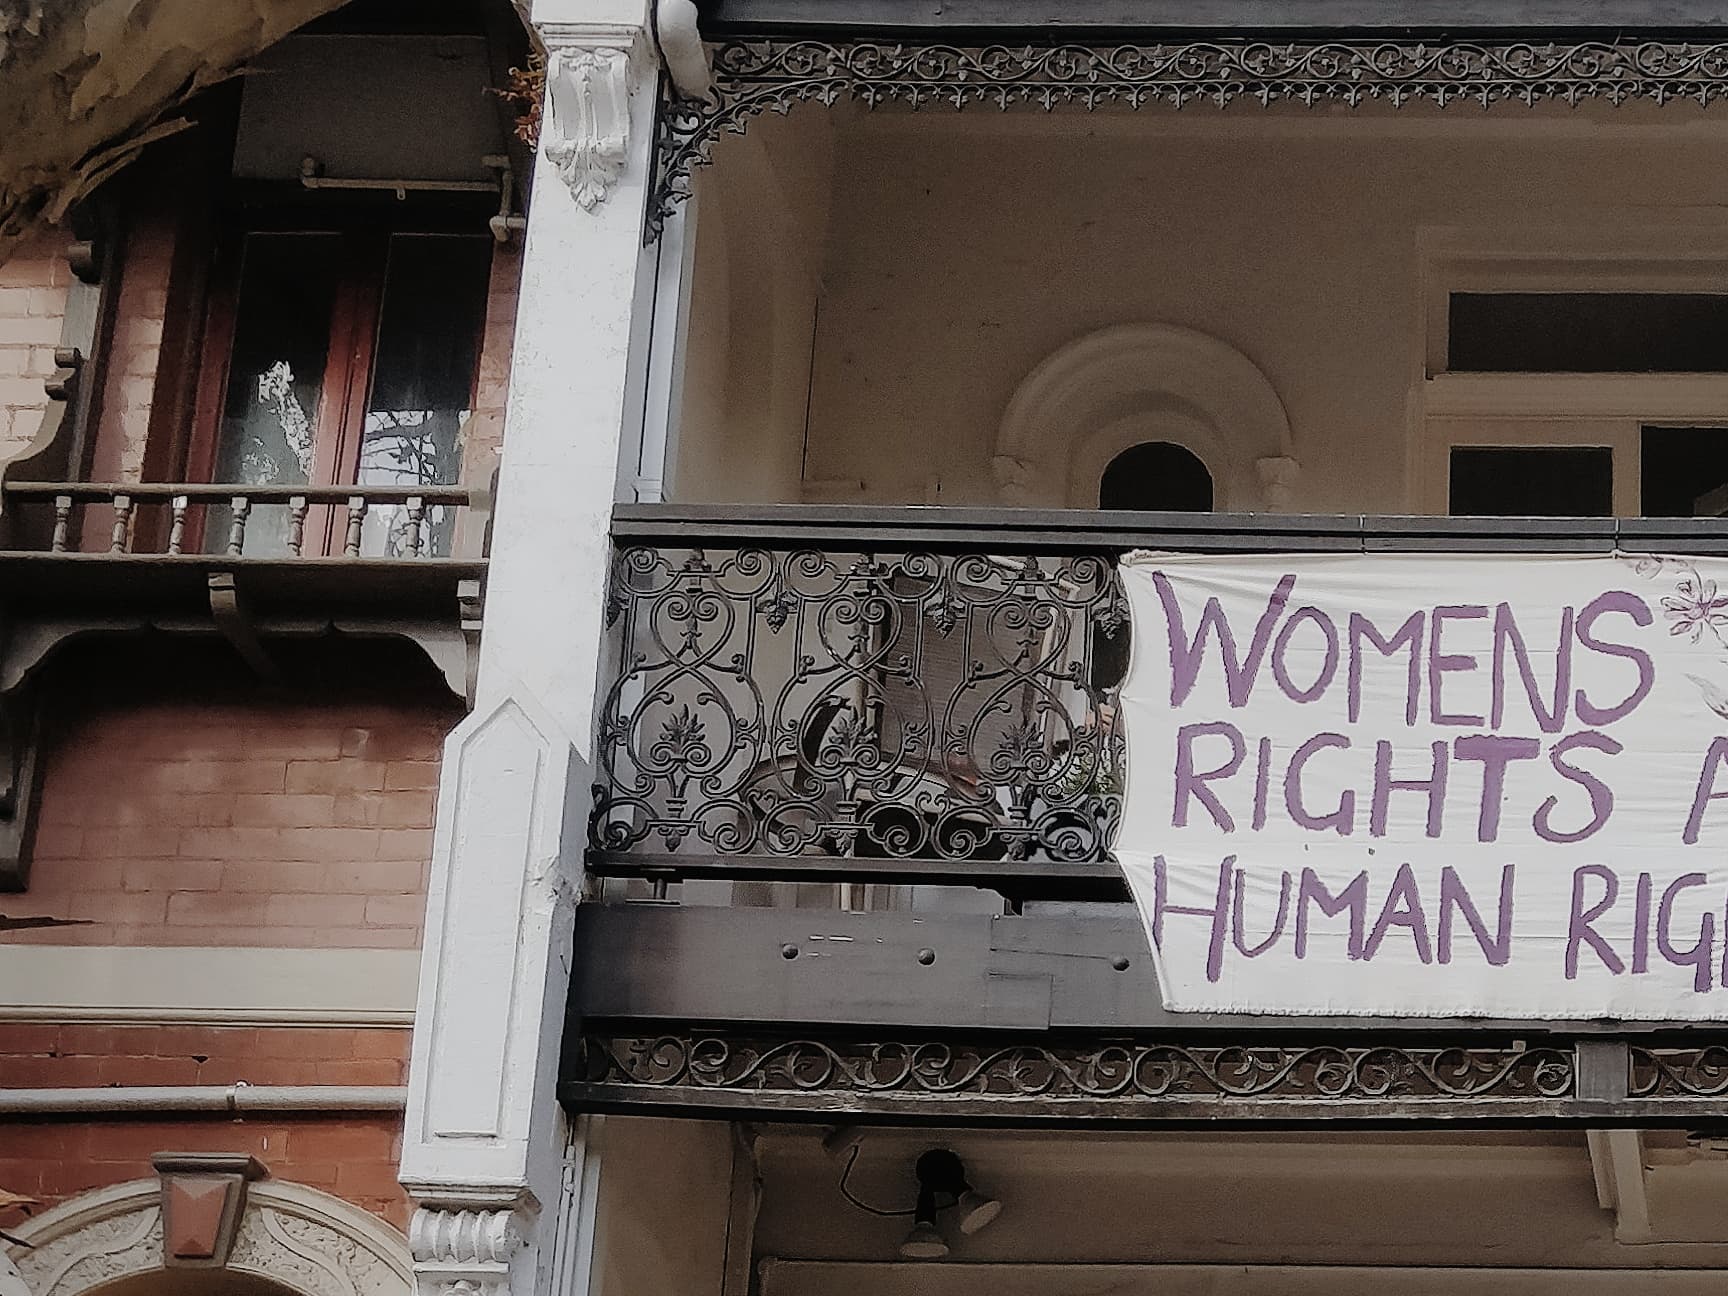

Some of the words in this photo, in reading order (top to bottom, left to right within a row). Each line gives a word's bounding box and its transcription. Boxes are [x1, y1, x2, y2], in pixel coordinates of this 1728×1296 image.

[1151, 570, 1655, 733] WOMENS
[1171, 721, 1625, 843] RIGHTS
[1153, 856, 1515, 983] HUMAN
